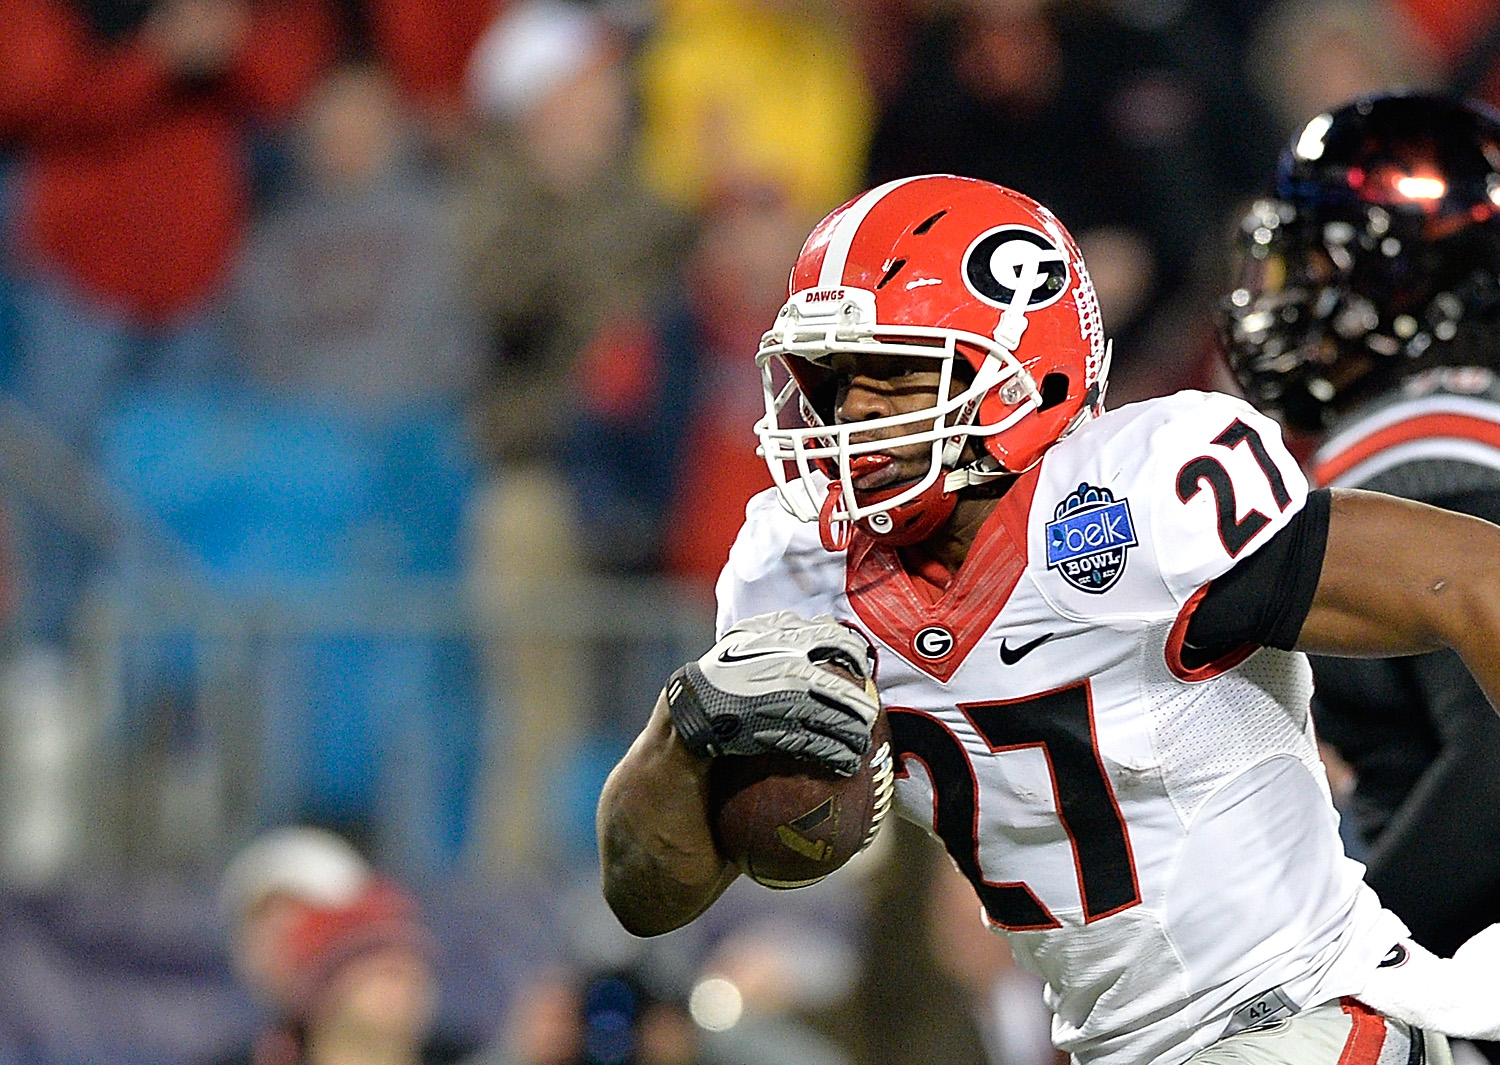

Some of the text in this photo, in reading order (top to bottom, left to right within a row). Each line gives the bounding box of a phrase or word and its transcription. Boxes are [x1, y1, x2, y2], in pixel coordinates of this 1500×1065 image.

[966, 228, 1067, 306] G
[806, 290, 845, 303] DAWGS
[1175, 417, 1292, 559] 27
[872, 514, 888, 526] G
[1065, 512, 1128, 552] belk
[1066, 552, 1121, 576] BOWL
[915, 627, 951, 657] G
[885, 677, 1142, 932] 27
[1250, 1001, 1272, 1019] 42
